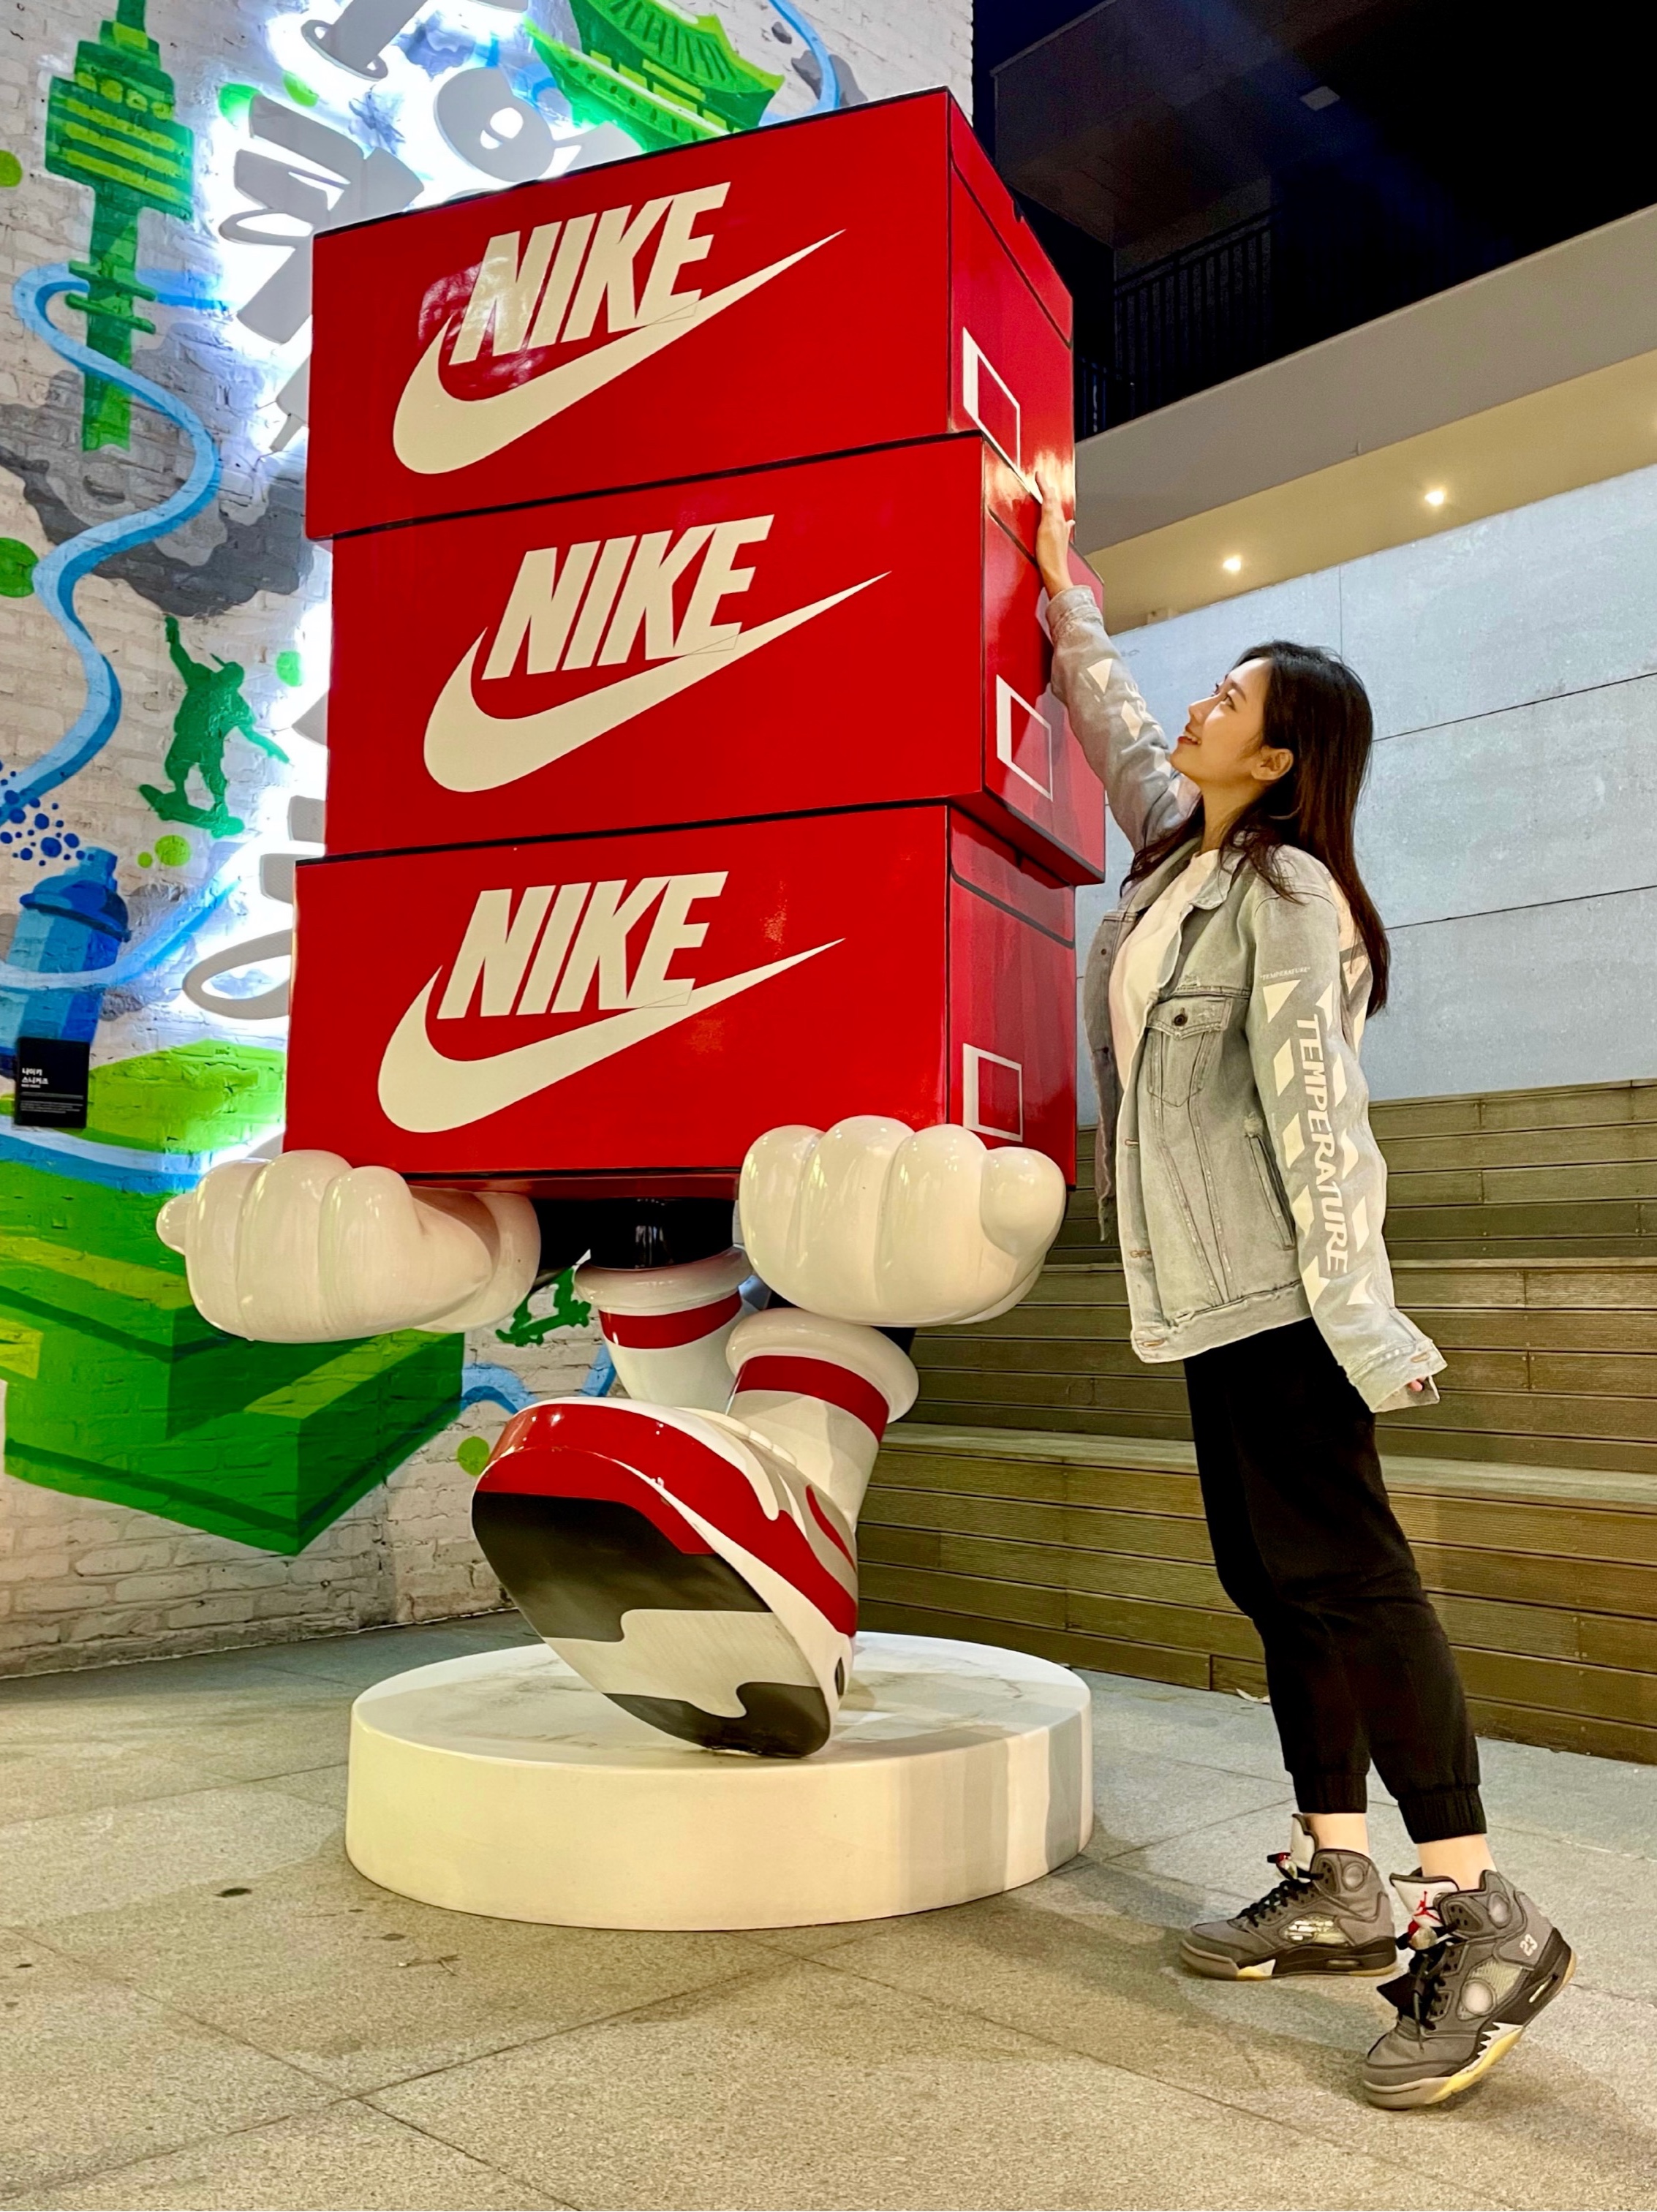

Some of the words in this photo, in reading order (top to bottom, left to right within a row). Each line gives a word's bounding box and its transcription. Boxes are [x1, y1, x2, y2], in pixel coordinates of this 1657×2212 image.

[448, 181, 731, 366] NIKE
[481, 514, 774, 681] NIKE
[437, 871, 729, 1019] NIKE
[1296, 1013, 1348, 1274] TEMPERATURE
[1520, 1934, 1538, 1956] 23
